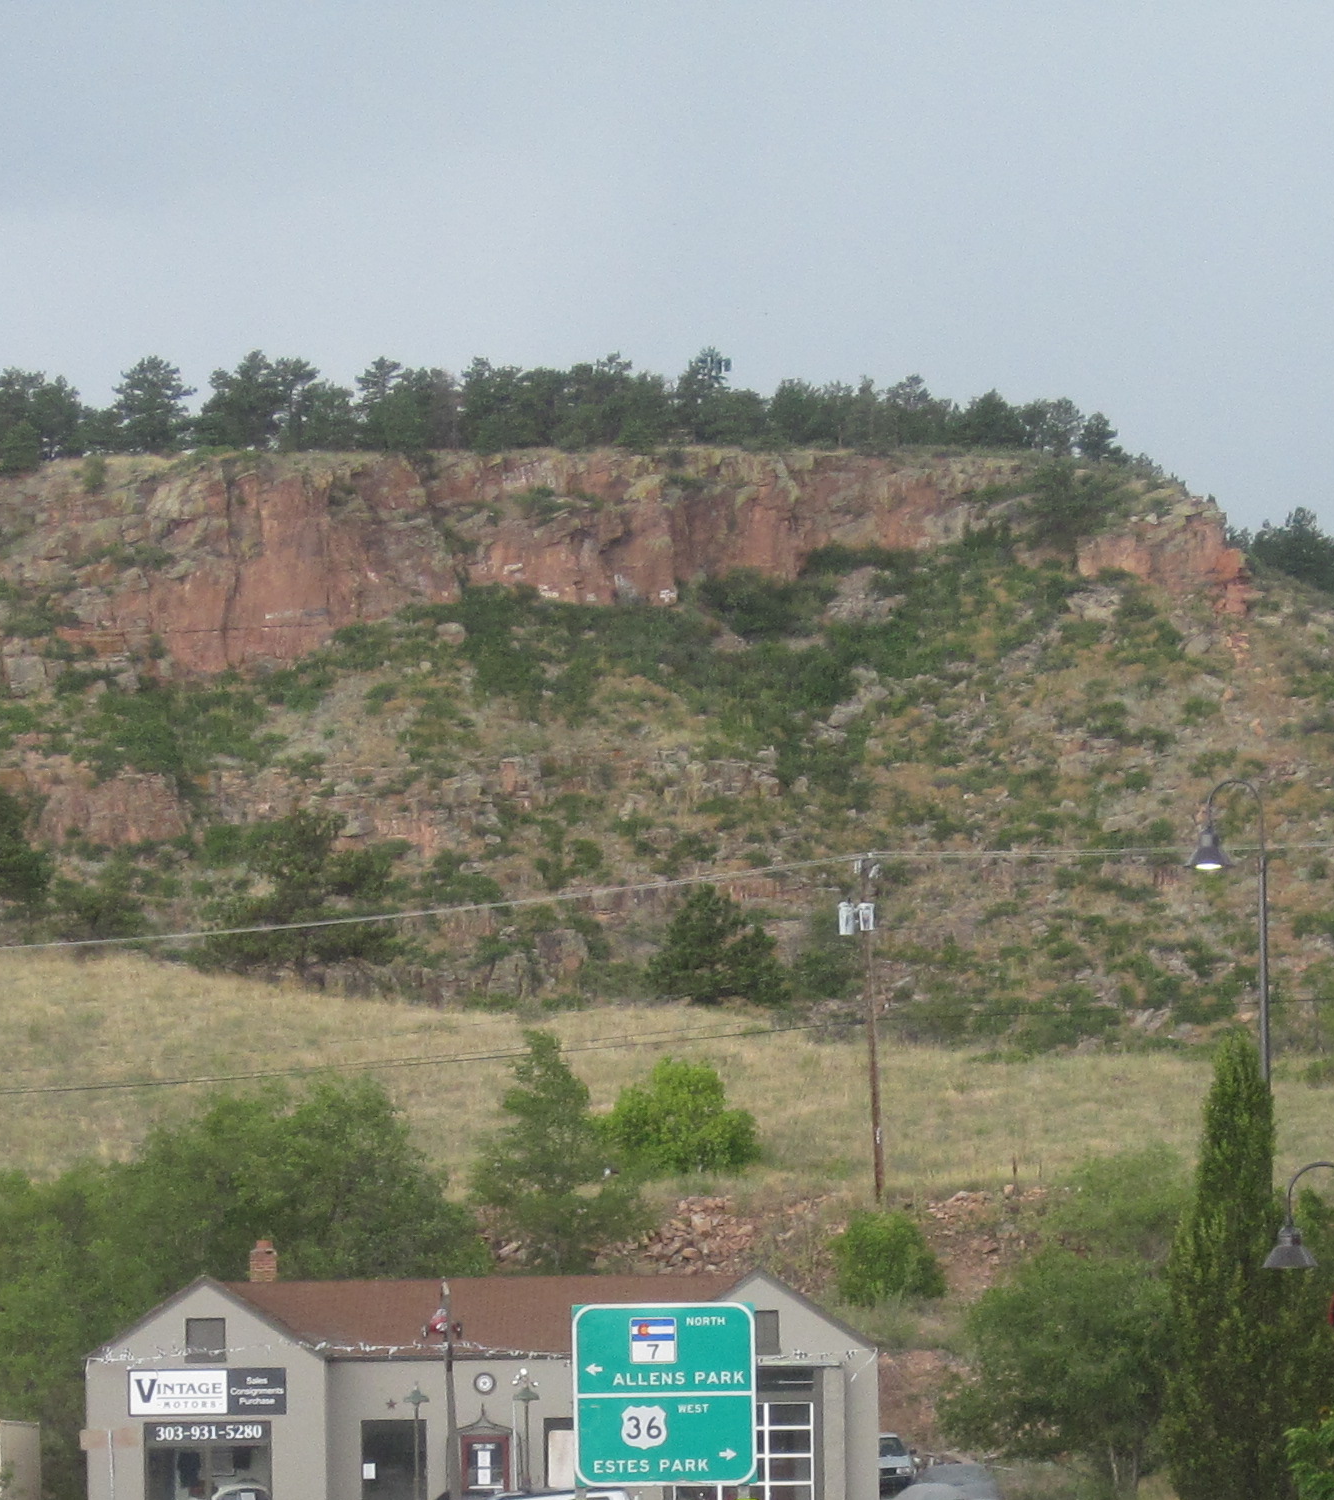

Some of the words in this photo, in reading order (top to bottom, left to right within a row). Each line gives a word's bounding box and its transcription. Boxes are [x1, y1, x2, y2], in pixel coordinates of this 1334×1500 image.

[686, 1316, 726, 1326] NORTH
[647, 1344, 659, 1360] 7
[246, 1376, 268, 1385] Sales
[613, 1372, 685, 1386] ALLENS
[694, 1371, 745, 1385] PARK
[135, 1378, 223, 1404] VINTAGE
[230, 1387, 285, 1398] Consignments
[239, 1397, 276, 1406] Purchase
[677, 1403, 709, 1414] WEST
[155, 1424, 263, 1441] 303-931-5280
[626, 1416, 662, 1440] 36
[593, 1460, 650, 1474] ESTES
[659, 1459, 709, 1473] PARK
